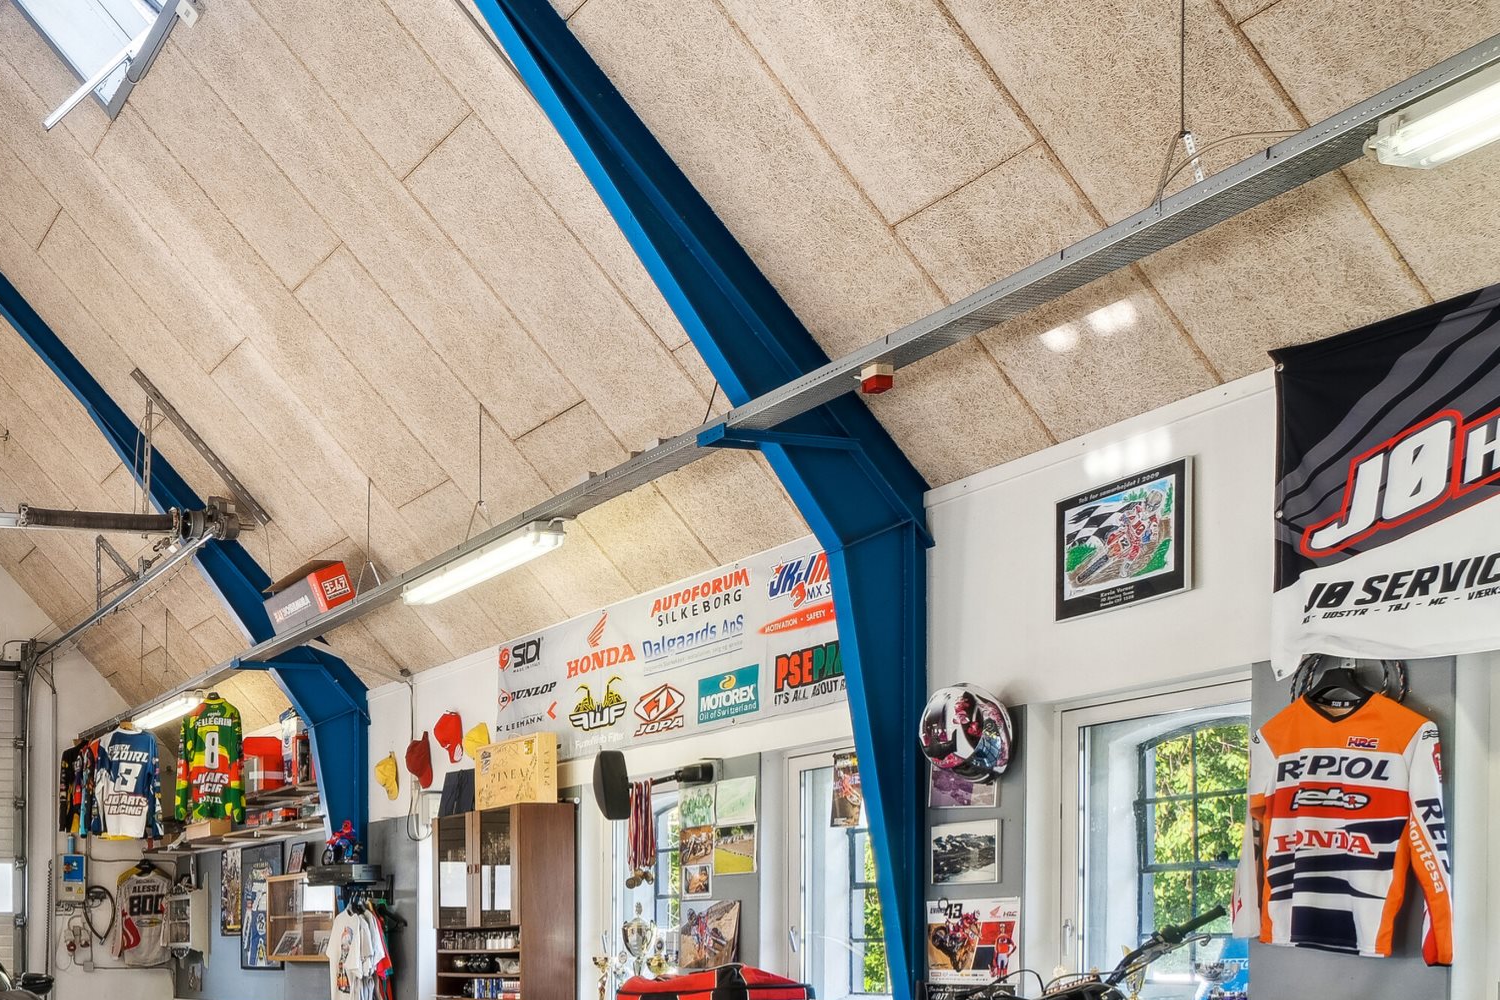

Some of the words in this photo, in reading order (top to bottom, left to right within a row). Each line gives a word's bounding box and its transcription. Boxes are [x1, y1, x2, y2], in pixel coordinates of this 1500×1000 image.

[651, 567, 750, 618] AUTOFORUM
[657, 589, 742, 627] SILKEBORG
[1322, 608, 1368, 619] UDSTYR
[1428, 596, 1448, 607] MC
[764, 618, 798, 633] MOTIVATION
[806, 609, 826, 621] SAFETY
[642, 622, 716, 660] Dalgaards
[722, 614, 743, 637] ApS
[566, 643, 636, 679] HONDA
[510, 681, 557, 702] DUNLOP
[700, 684, 756, 712] MOTOREX
[792, 689, 808, 702] ALL
[700, 709, 709, 721] Oil
[716, 701, 757, 718] Switzerland
[634, 715, 684, 737] JOPA
[205, 731, 219, 769] 8
[1348, 737, 1378, 749] HRC
[1277, 755, 1390, 782] REPSOL
[132, 884, 160, 893] ALESSI
[944, 903, 963, 919] 43
